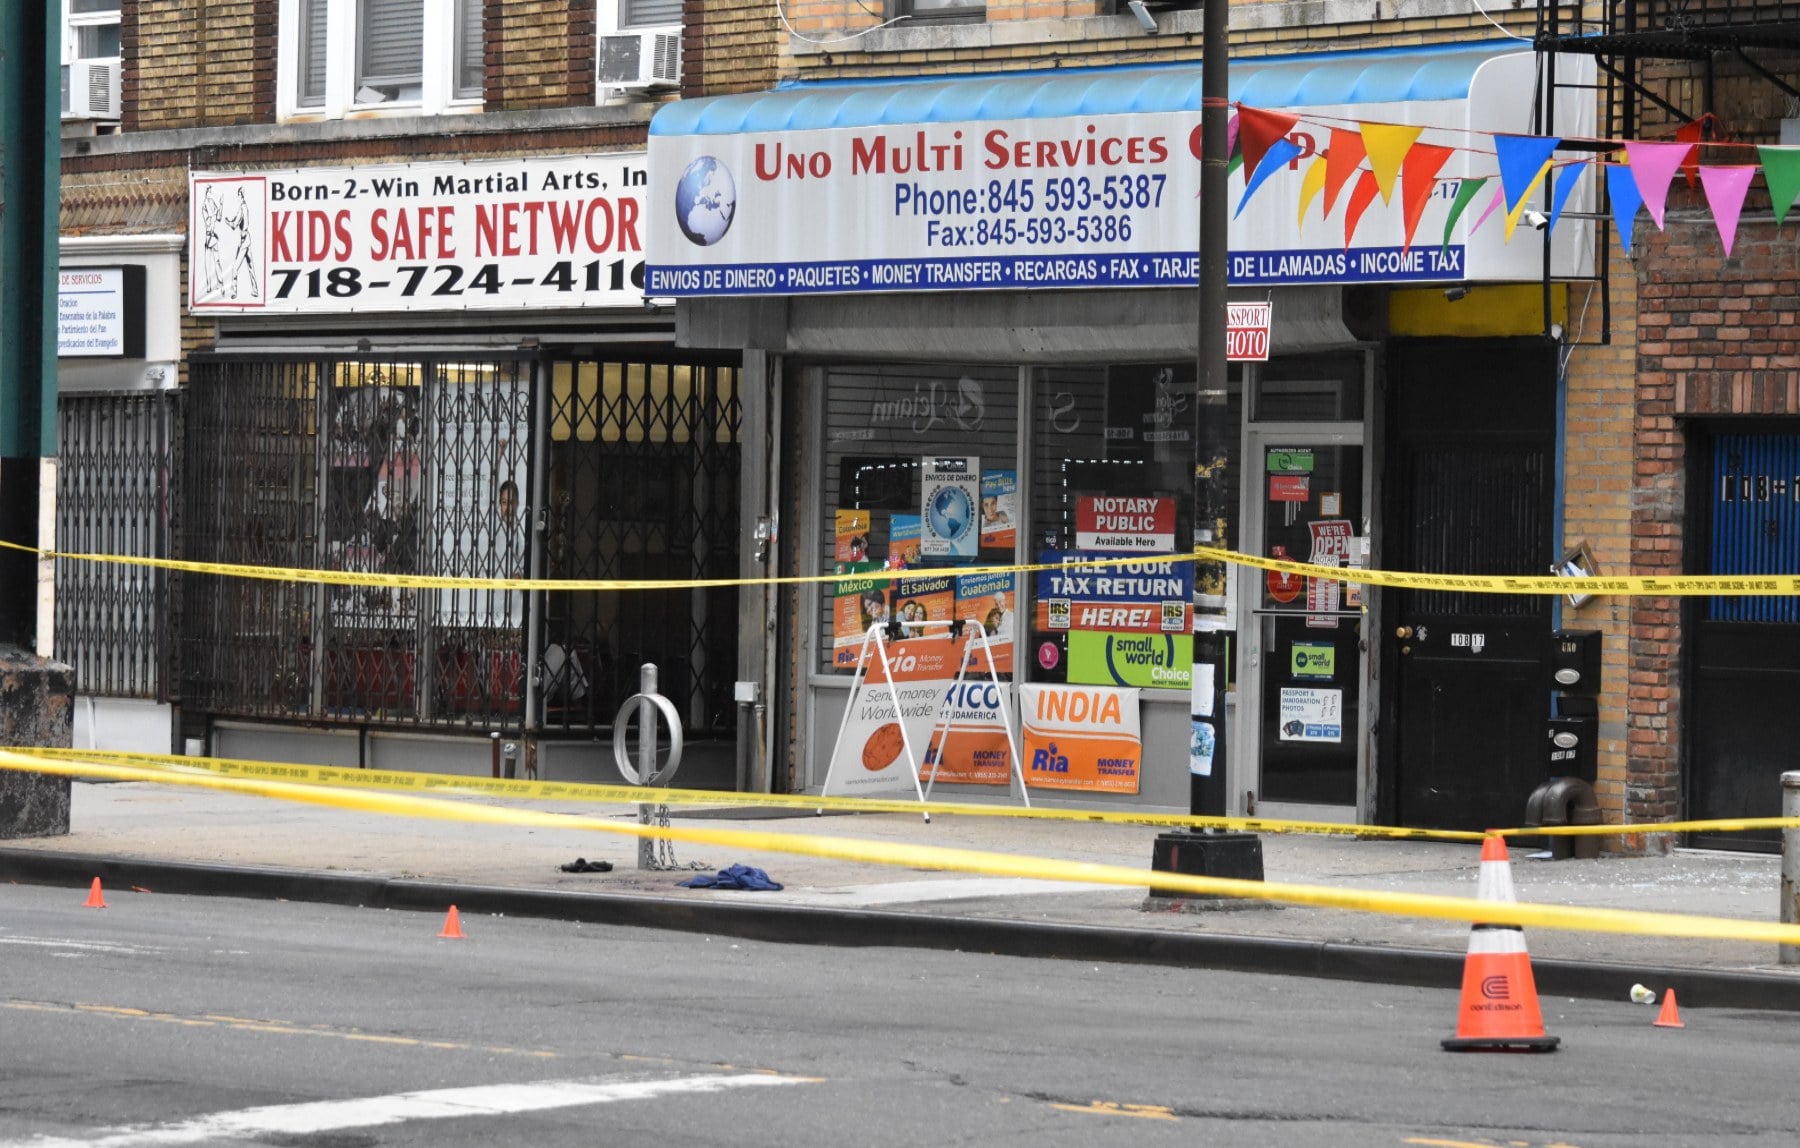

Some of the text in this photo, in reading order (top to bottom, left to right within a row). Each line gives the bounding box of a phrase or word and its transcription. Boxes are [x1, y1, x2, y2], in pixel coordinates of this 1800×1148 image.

[271, 177, 419, 202] Born-2-Win
[433, 171, 528, 195] Martial
[542, 170, 608, 191] Arts,
[895, 173, 1167, 216] Phone:845 593-5387
[271, 209, 353, 263] KIDS
[370, 206, 457, 261] SAFE
[927, 214, 1132, 247] Fax:845-593-5386
[651, 269, 700, 290] ENVIOS
[703, 269, 722, 289] DE
[725, 268, 776, 289] DINERO
[788, 265, 860, 288] PAQUETES
[872, 263, 922, 284] MONEY
[925, 261, 1002, 283] TRANSFER
[1014, 259, 1097, 281] RECARGAS
[1110, 258, 1140, 280] FAX
[1233, 256, 1256, 278] DE
[1259, 254, 1346, 278] LLAMADAS
[1360, 251, 1424, 274] INCOME
[1429, 250, 1460, 272] TAX
[925, 474, 946, 482] ENVIOS
[1093, 497, 1159, 514] NOTARY
[1095, 515, 1155, 531] PUBLIC
[1317, 525, 1346, 536] WE'RE
[1095, 536, 1156, 547] Available Here
[1315, 535, 1350, 555] OPEN
[1062, 556, 1107, 575] FILE
[838, 579, 873, 594] México
[901, 579, 950, 596] El Salvador
[960, 580, 1011, 597] Guatemala
[1050, 577, 1183, 597] TAX RETURN
[1050, 603, 1069, 614] IRS
[1163, 605, 1183, 617] IRS
[1080, 608, 1152, 628] HERE!
[1116, 636, 1152, 653] small
[1126, 649, 1164, 666] world
[1151, 666, 1190, 681] Choice
[899, 688, 941, 702] money
[1282, 689, 1309, 697] PASSPORT
[1282, 697, 1321, 705] IMMIGRATION
[1037, 690, 1121, 725] INDIA
[973, 751, 1008, 760] MONEY
[1031, 742, 1069, 773] Ria
[1097, 758, 1136, 768] MONEY
[1097, 767, 1136, 776] TRANSFER
